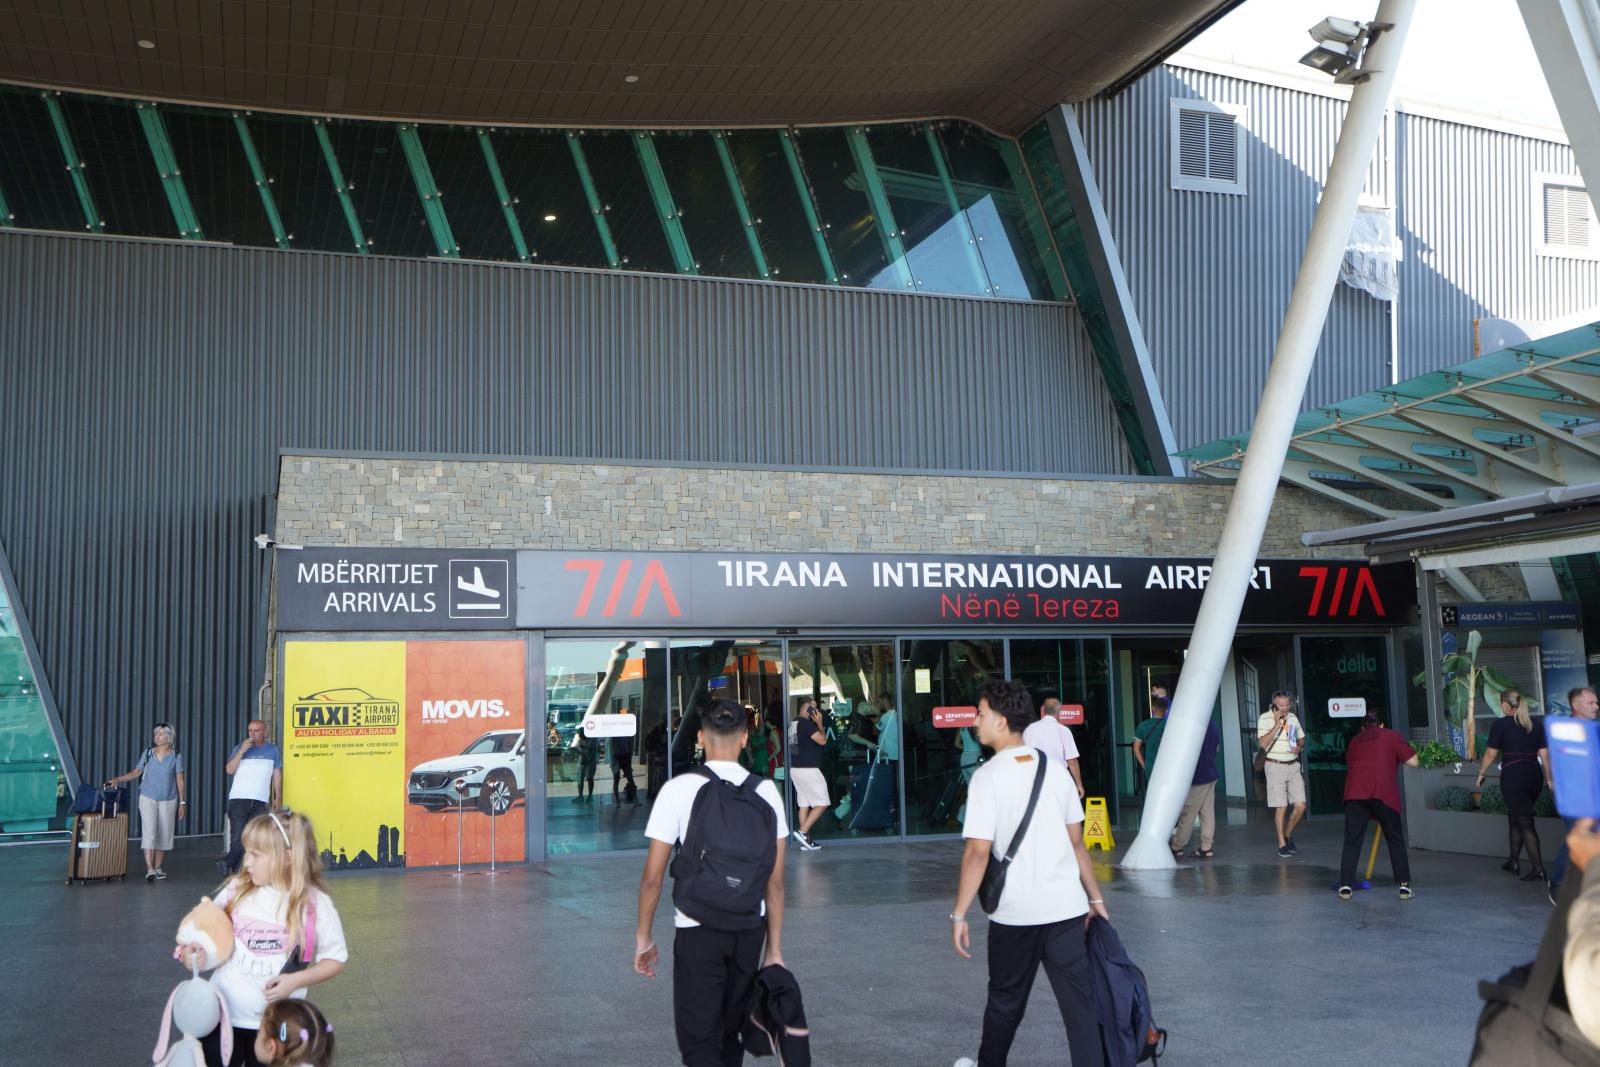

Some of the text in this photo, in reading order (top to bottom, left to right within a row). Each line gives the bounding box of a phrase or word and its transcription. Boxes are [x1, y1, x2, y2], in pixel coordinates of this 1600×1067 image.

[297, 560, 438, 584] MBËRRITJET
[718, 560, 1272, 590] TIRANA INTERNATIONAL AIRPRT
[324, 592, 436, 612] ARRIVALS
[941, 592, 1120, 618] Nënë Tereza
[1460, 613, 1495, 621] AEGEAN
[1337, 653, 1377, 673] delta
[295, 705, 397, 727] TAXI TIRANA
[364, 714, 397, 724] AIRPORT
[359, 727, 393, 735] ALBANIA
